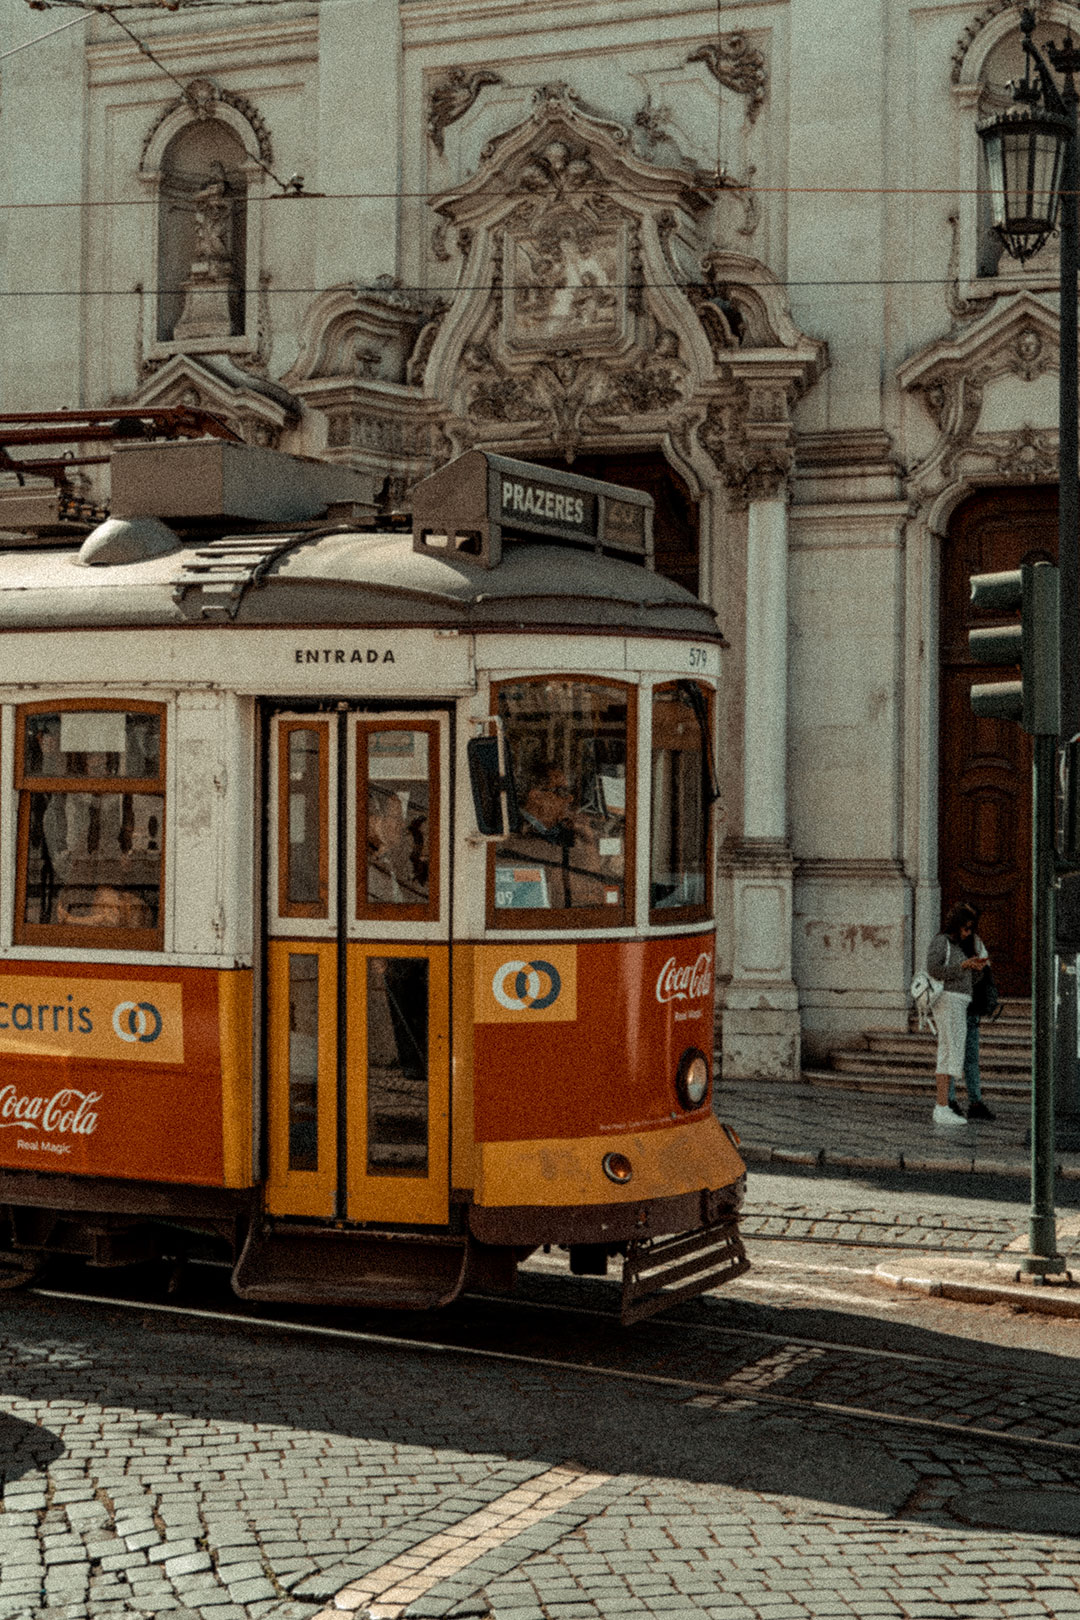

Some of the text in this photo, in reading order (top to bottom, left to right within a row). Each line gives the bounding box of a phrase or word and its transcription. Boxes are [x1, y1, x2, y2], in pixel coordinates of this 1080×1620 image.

[502, 481, 584, 524] PRAZERES
[295, 649, 395, 663] ENTRADA
[690, 647, 707, 667] 579
[17, 1139, 72, 1155] Real Magic
